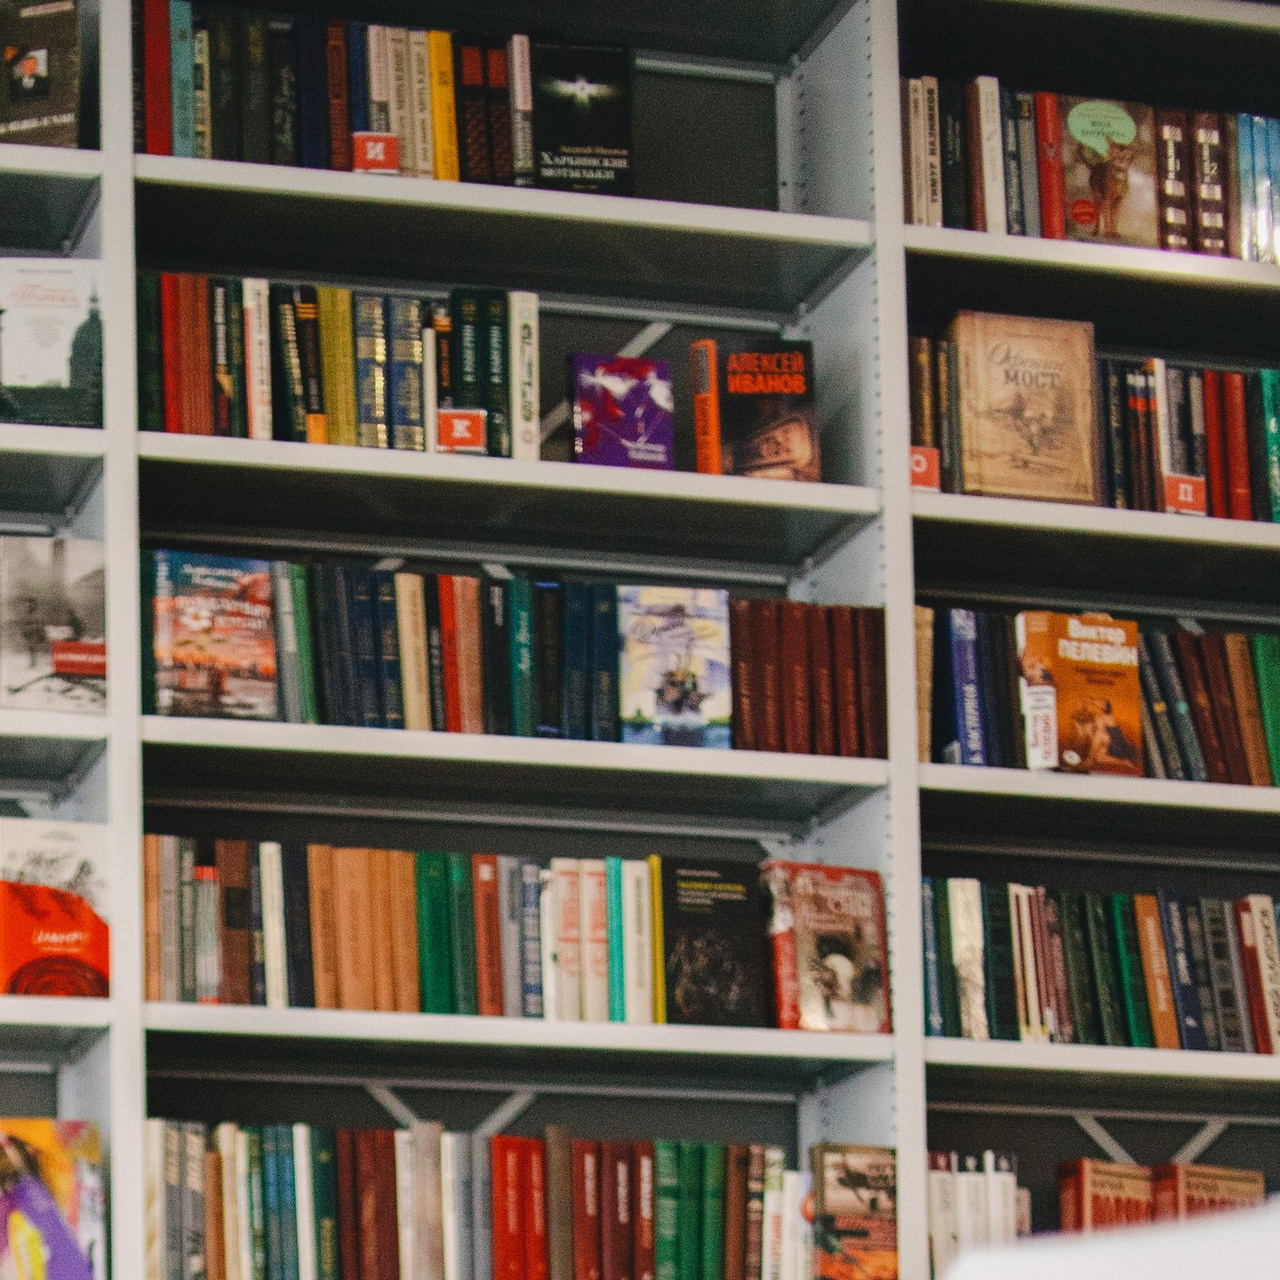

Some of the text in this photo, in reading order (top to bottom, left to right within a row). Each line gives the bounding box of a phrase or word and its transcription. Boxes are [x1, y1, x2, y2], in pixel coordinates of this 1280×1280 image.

[366, 141, 386, 161] И
[727, 350, 805, 373] АЛЕКСЕЙ
[727, 372, 807, 395] ИВАНОВ
[1004, 370, 1061, 391] МОСТ
[450, 418, 473, 439] К
[911, 453, 928, 473] О
[1177, 484, 1195, 503] П
[1068, 618, 1127, 647] Виктор
[1057, 639, 1138, 666] ПЕЛЕВИН
